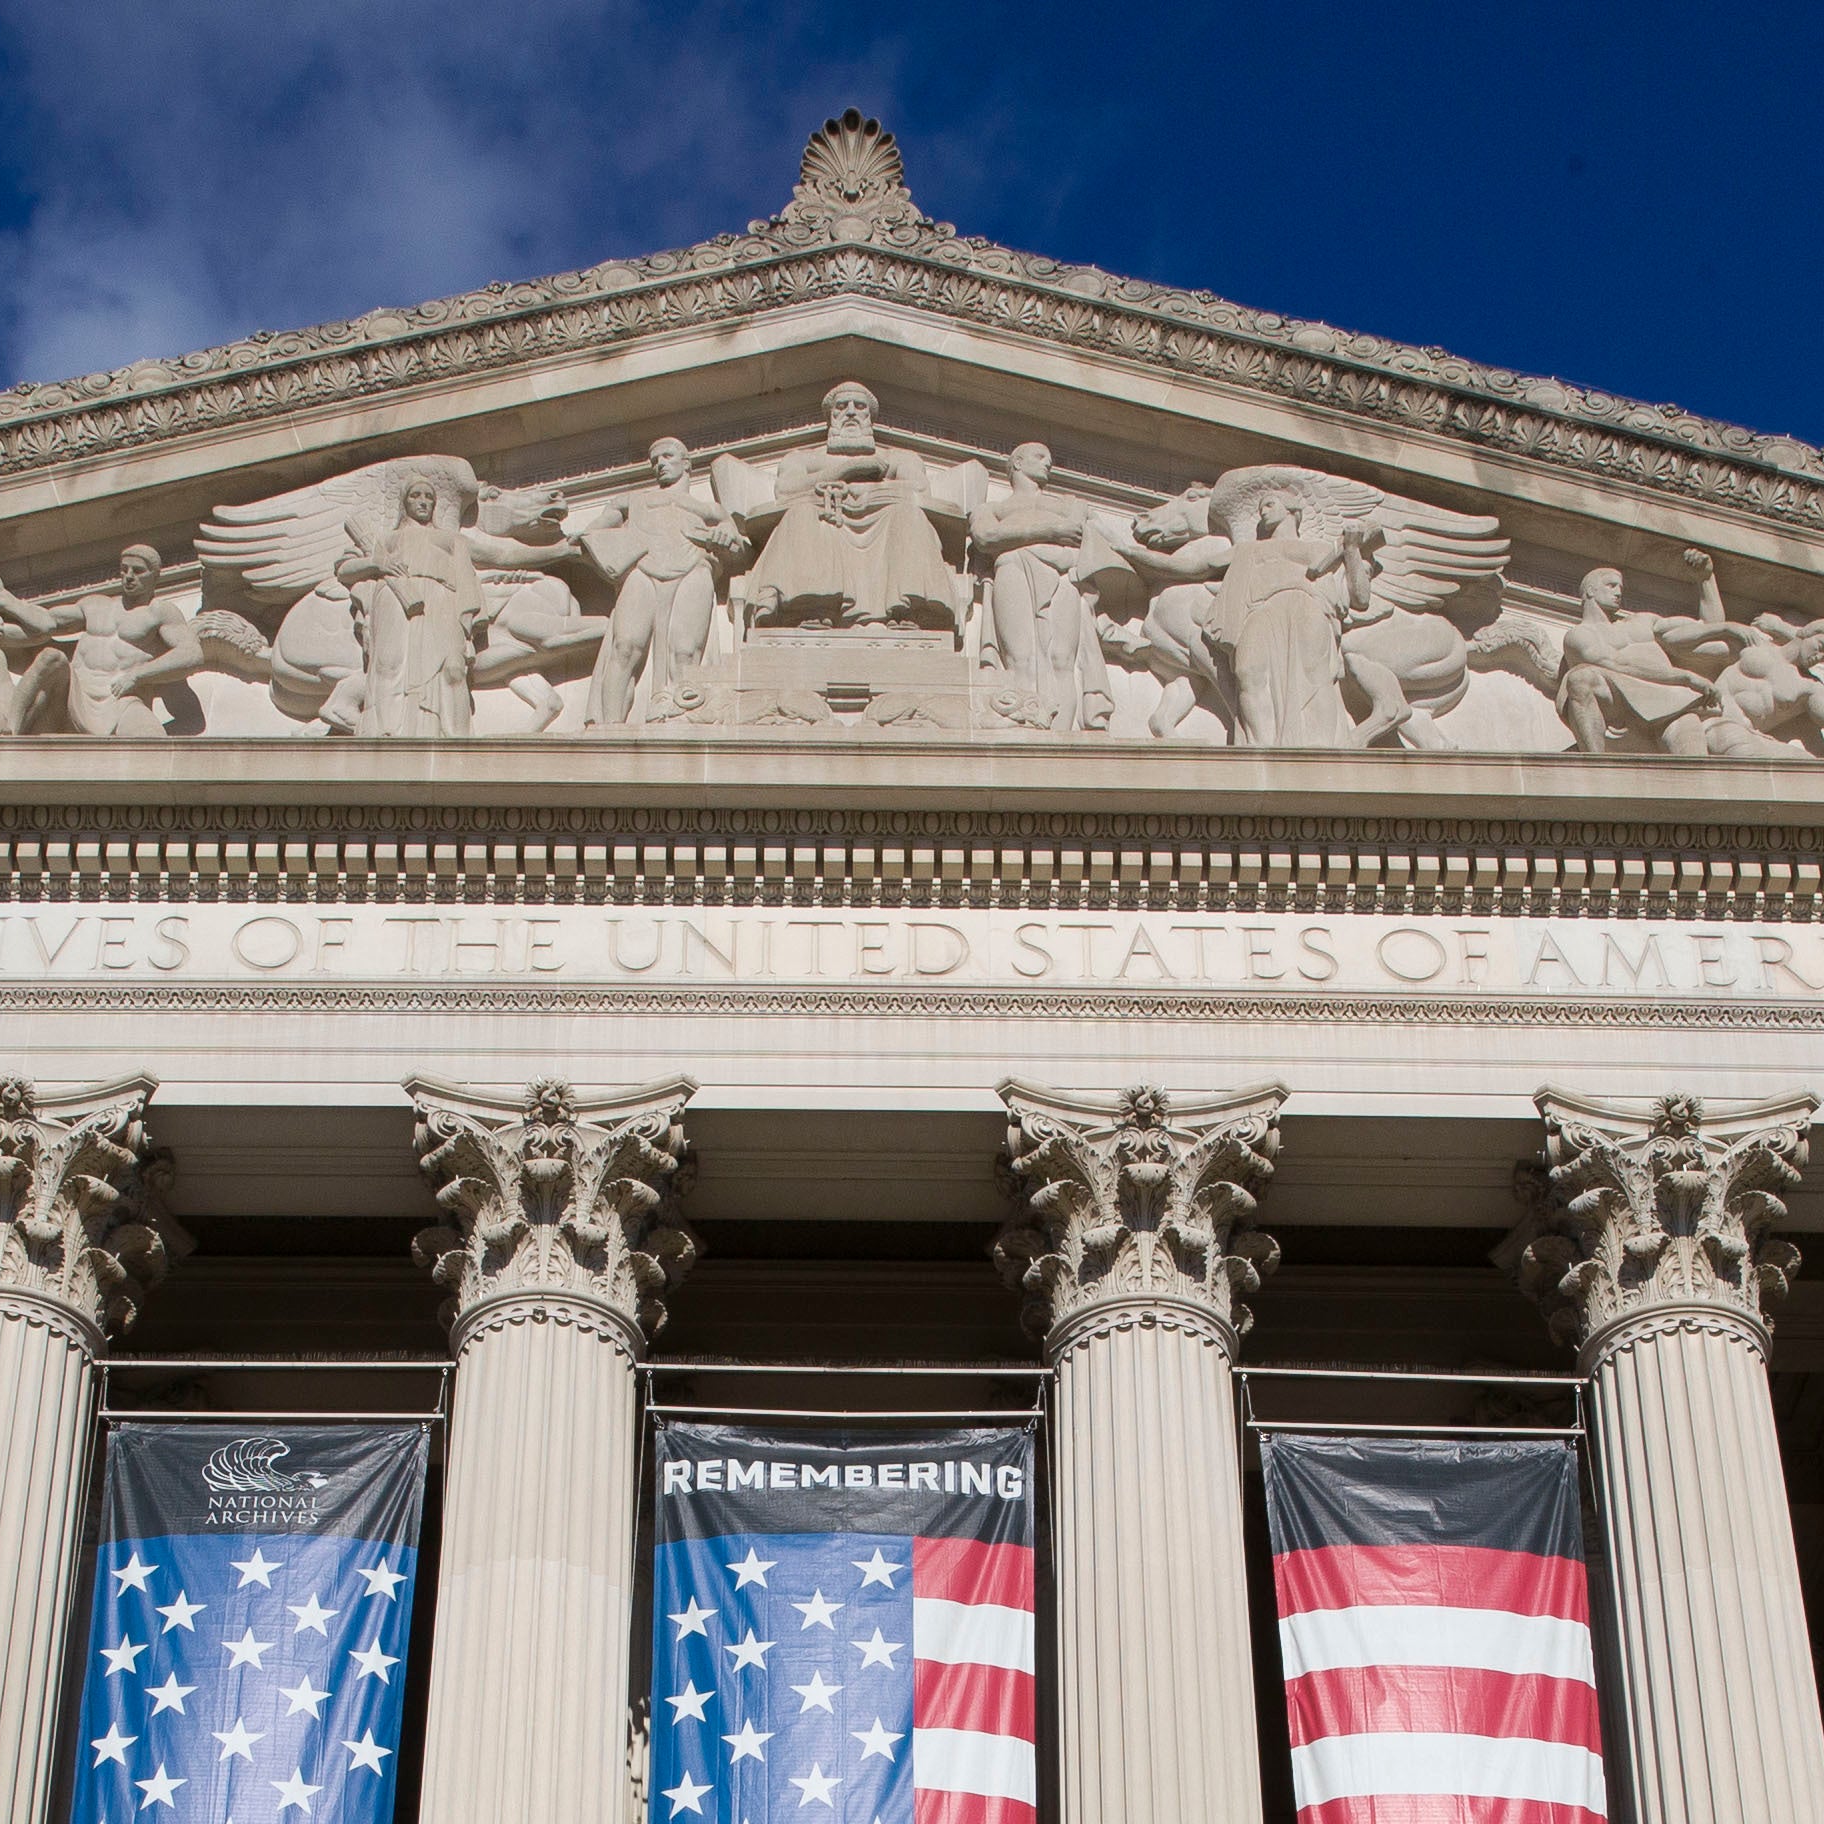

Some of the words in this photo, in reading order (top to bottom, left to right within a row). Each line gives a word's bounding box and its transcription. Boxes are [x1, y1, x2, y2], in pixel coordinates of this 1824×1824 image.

[232, 915, 353, 972] OF
[383, 917, 566, 973] THE
[604, 919, 971, 977] UNITED
[1011, 922, 1339, 981] STATES
[1376, 928, 1491, 984] OF
[662, 1458, 1025, 1499] REMEMBERING
[208, 1496, 318, 1510] NATIONAL
[205, 1510, 319, 1525] ARCHIVES
